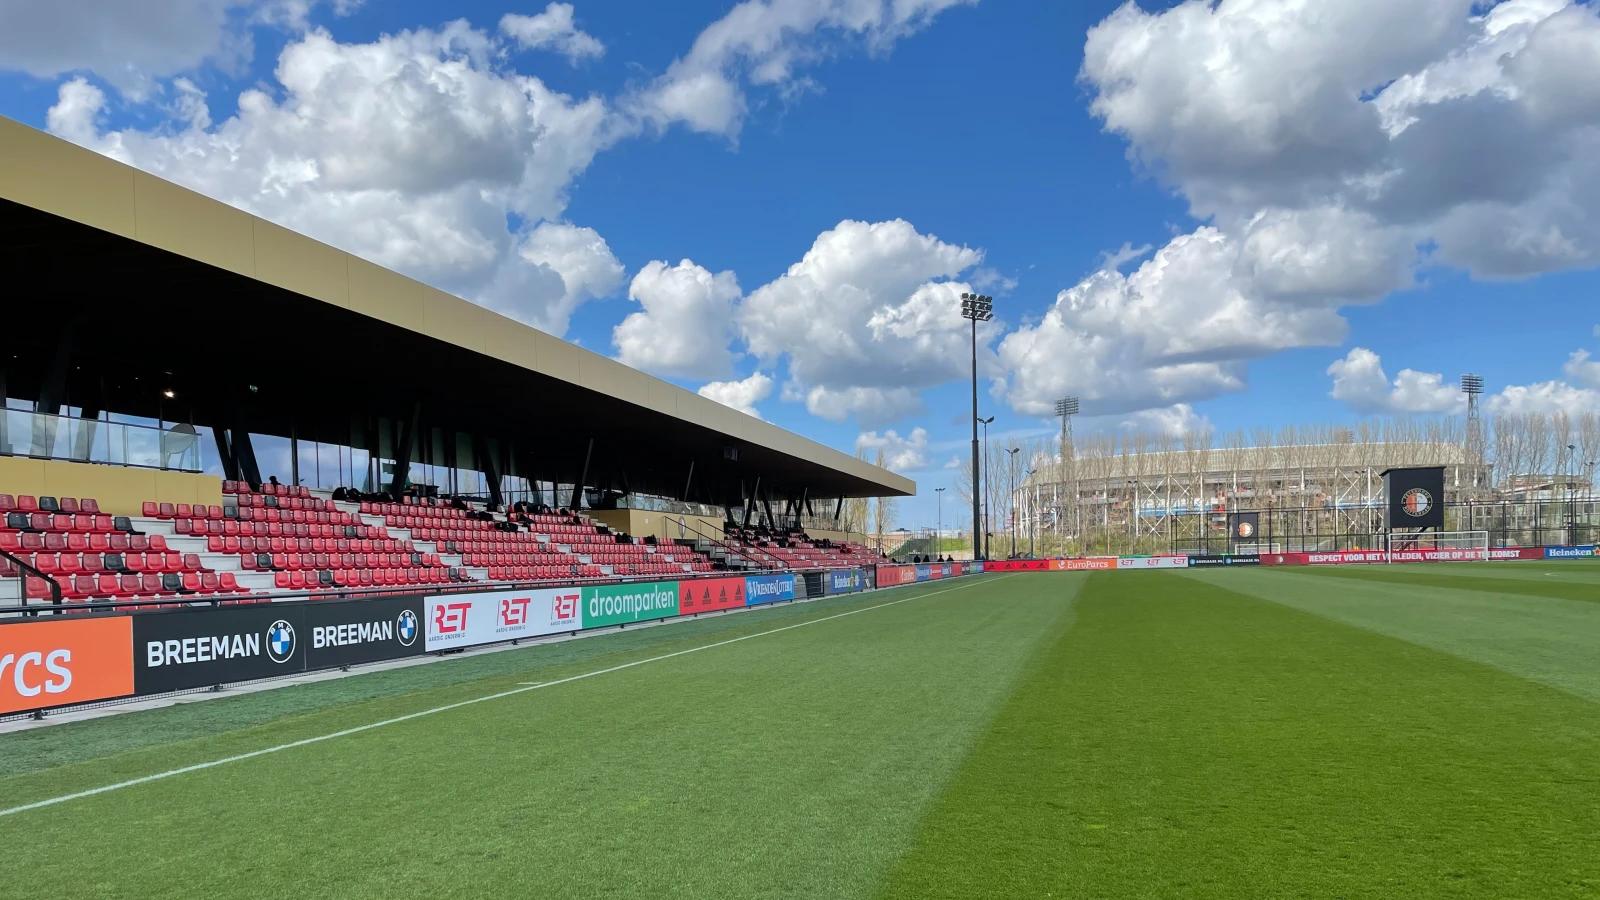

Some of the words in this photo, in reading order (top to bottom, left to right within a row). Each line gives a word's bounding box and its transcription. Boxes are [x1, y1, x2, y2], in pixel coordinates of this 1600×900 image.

[1147, 558, 1160, 566] RET
[1308, 554, 1343, 562] RESPECT
[1343, 553, 1364, 561] VOOR
[1366, 553, 1381, 561] HET
[1425, 551, 1450, 560] VIZIER
[1452, 551, 1463, 559] OP
[1465, 551, 1476, 559] DE
[1549, 548, 1592, 557] Heineken
[1067, 560, 1108, 569] EuroParcs
[555, 594, 580, 619] RET
[589, 584, 675, 619] droomparken
[398, 611, 415, 623] BMW
[435, 602, 472, 633] RET
[501, 597, 531, 626] RET
[270, 622, 292, 635] BMW
[313, 620, 393, 649] BREEMAN
[147, 633, 260, 667] BREEMAN
